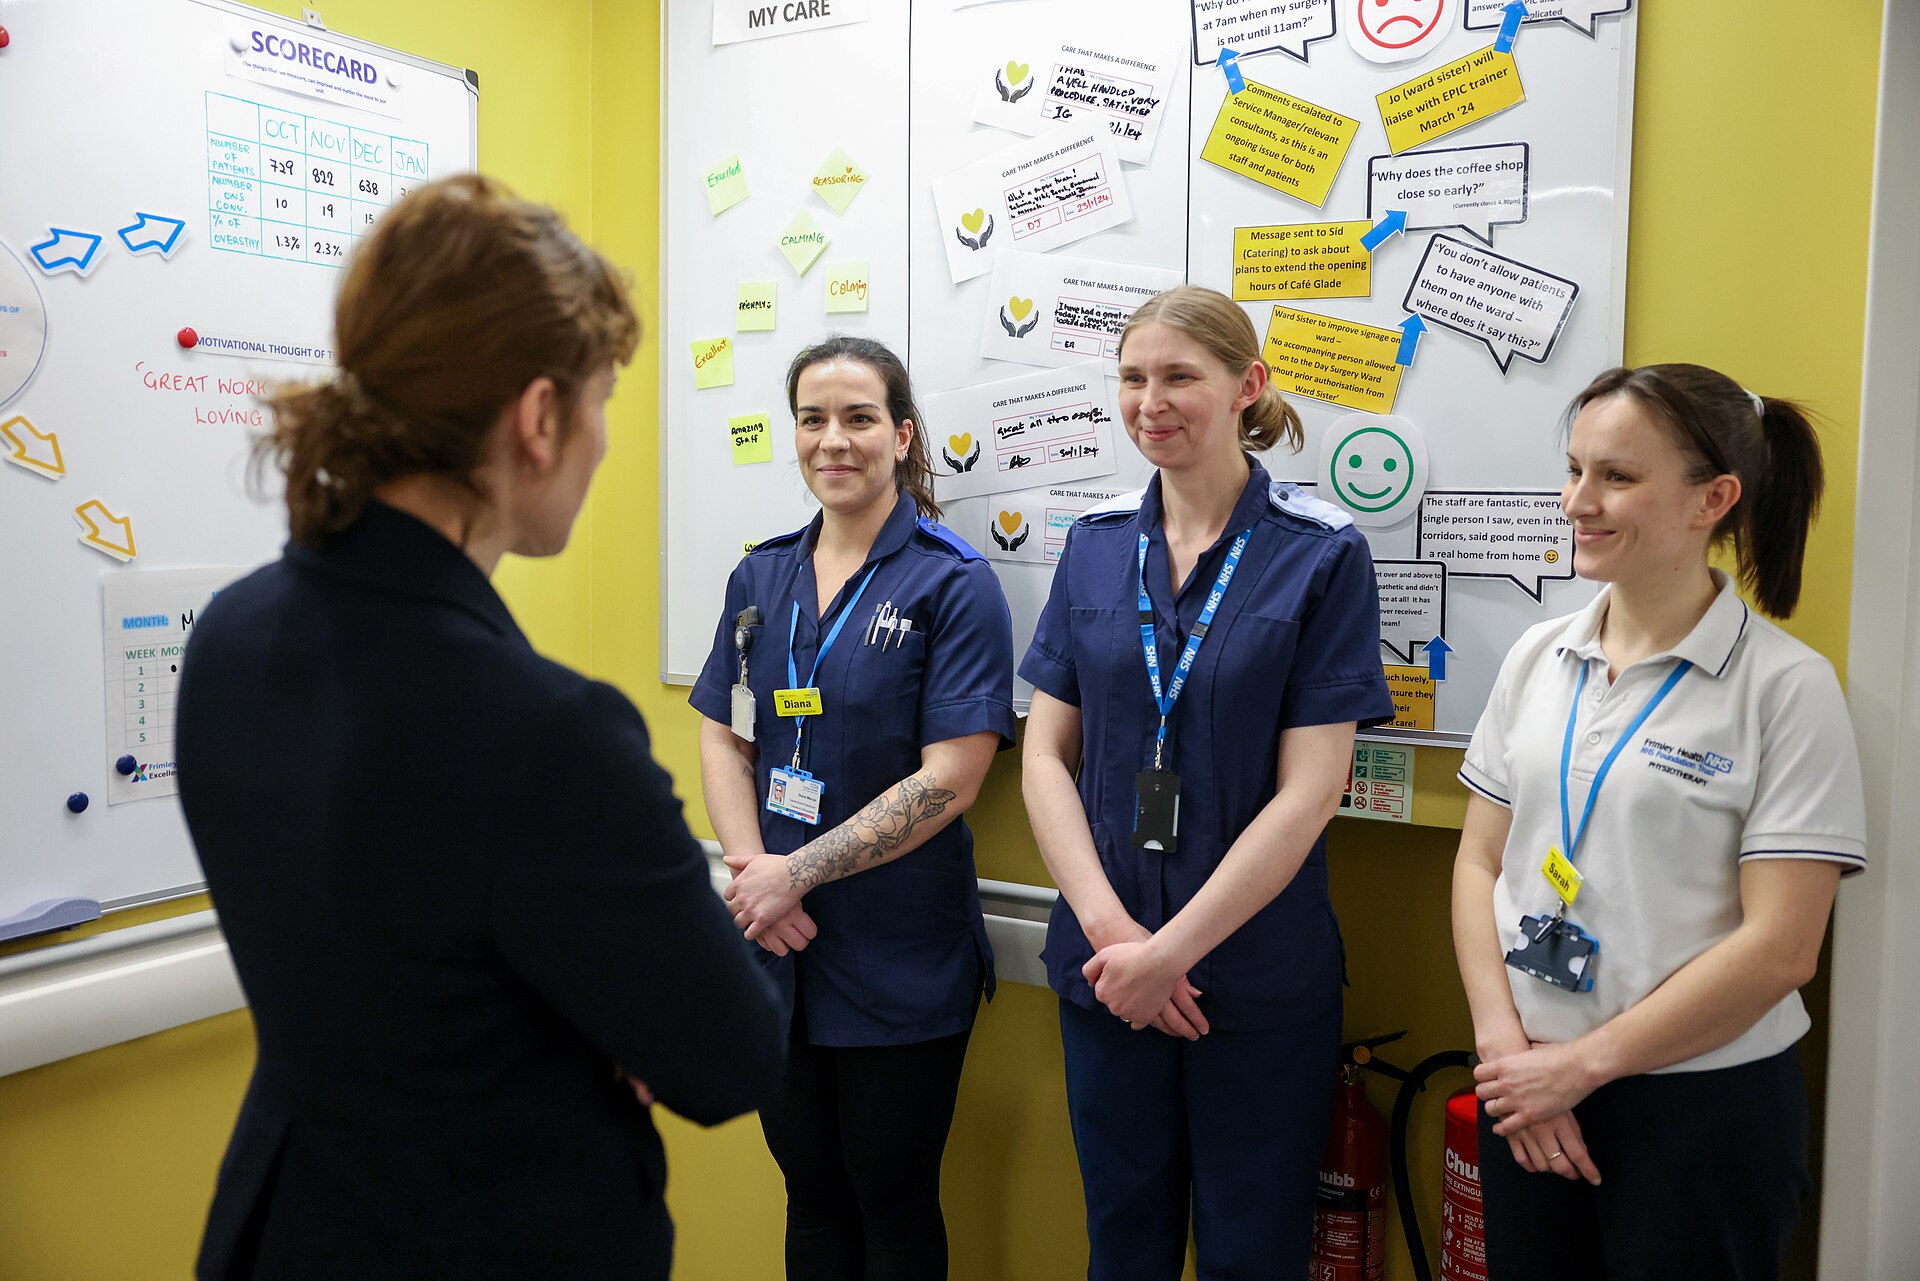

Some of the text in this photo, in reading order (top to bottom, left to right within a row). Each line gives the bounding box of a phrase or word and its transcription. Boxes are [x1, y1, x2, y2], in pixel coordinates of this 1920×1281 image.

[749, 0, 830, 28] MY CARE
[1203, 0, 1328, 30] at 7am when my surgery
[1217, 37, 1225, 46] is
[1228, 33, 1244, 44] not
[1247, 26, 1270, 40] until
[251, 30, 378, 84] SCORECARD
[1062, 45, 1076, 53] CARE
[1078, 49, 1093, 57] THAT
[1094, 52, 1114, 62] MAKES
[1121, 58, 1156, 71] DIFFERENCE
[1389, 51, 1494, 105] Jo (ward sister) will
[1247, 83, 1342, 127] Comments escalated to
[1385, 67, 1508, 126] liaise with EPIC trainer
[1233, 97, 1339, 144] Service Manager/relevant
[1420, 111, 1455, 133] March
[210, 138, 250, 154] NUMBER
[225, 152, 237, 161] OF
[266, 119, 425, 174] OCT NOV DEC JAN
[1002, 168, 1017, 178] CARE
[1018, 161, 1033, 171] THAT
[1033, 152, 1054, 165] MAKES
[1060, 136, 1095, 154] DIFFERENCE
[212, 160, 255, 176] PATIENTS
[270, 159, 379, 196] 729 822 638
[1229, 152, 1299, 188] staff and patients
[1405, 167, 1431, 179] does
[1434, 166, 1453, 176] the
[1456, 161, 1492, 175] coffee
[1495, 160, 1523, 174] shop
[1398, 189, 1425, 200] close
[1428, 188, 1441, 196] so
[276, 198, 374, 224] 10 19 15
[214, 232, 260, 250] OVERSTAY
[781, 233, 824, 245] CALMING
[1251, 227, 1343, 241] Message sent to Sid
[276, 236, 342, 256] 1.3% 2.3%
[1250, 278, 1342, 291] hours of Café Glade
[1489, 265, 1519, 281] allow
[1520, 276, 1566, 299] patients
[1416, 298, 1448, 316] where
[1450, 311, 1475, 327] does
[1476, 320, 1485, 331] it
[1487, 327, 1505, 340] say
[197, 337, 266, 352] MOTIVATIONAL
[269, 344, 312, 357] THOUGHT
[314, 349, 325, 358] OF
[1279, 354, 1382, 383] on to the Day Surgery Ward
[218, 378, 267, 395] WORK
[993, 400, 1007, 408] CARE
[1009, 397, 1023, 405] THAT
[1025, 392, 1045, 401] MAKES
[1052, 384, 1086, 396] DIFFERENCE
[1426, 498, 1443, 507] The
[1445, 498, 1466, 507] staff
[1487, 498, 1530, 509] fantastic,
[1534, 500, 1561, 509] every
[1230, 536, 1246, 560] NHS
[1437, 550, 1454, 559] real
[1457, 551, 1483, 559] home
[1487, 551, 1509, 560] from
[1512, 552, 1540, 561] home
[1218, 563, 1233, 587] NHS
[1206, 589, 1221, 613] NHS
[123, 616, 168, 628] MONTH:
[126, 649, 155, 660] WEEK
[1146, 645, 1156, 667] NHS
[1180, 648, 1196, 672] NHS
[139, 667, 143, 675] 1
[1402, 674, 1429, 684] lovely,
[139, 683, 144, 692] 2
[1415, 690, 1434, 699] they
[139, 700, 144, 709] 3
[784, 700, 811, 709] Diana
[139, 716, 145, 725] 4
[140, 733, 145, 742] 5
[1644, 738, 1732, 772] Frimley Health NHS
[149, 762, 177, 770] Frimley
[1648, 761, 1708, 786] PHYSIOTHERAPY
[1549, 863, 1569, 891] Sarah
[1446, 1148, 1480, 1181] Chu
[1453, 1182, 1482, 1197] EXTINGU
